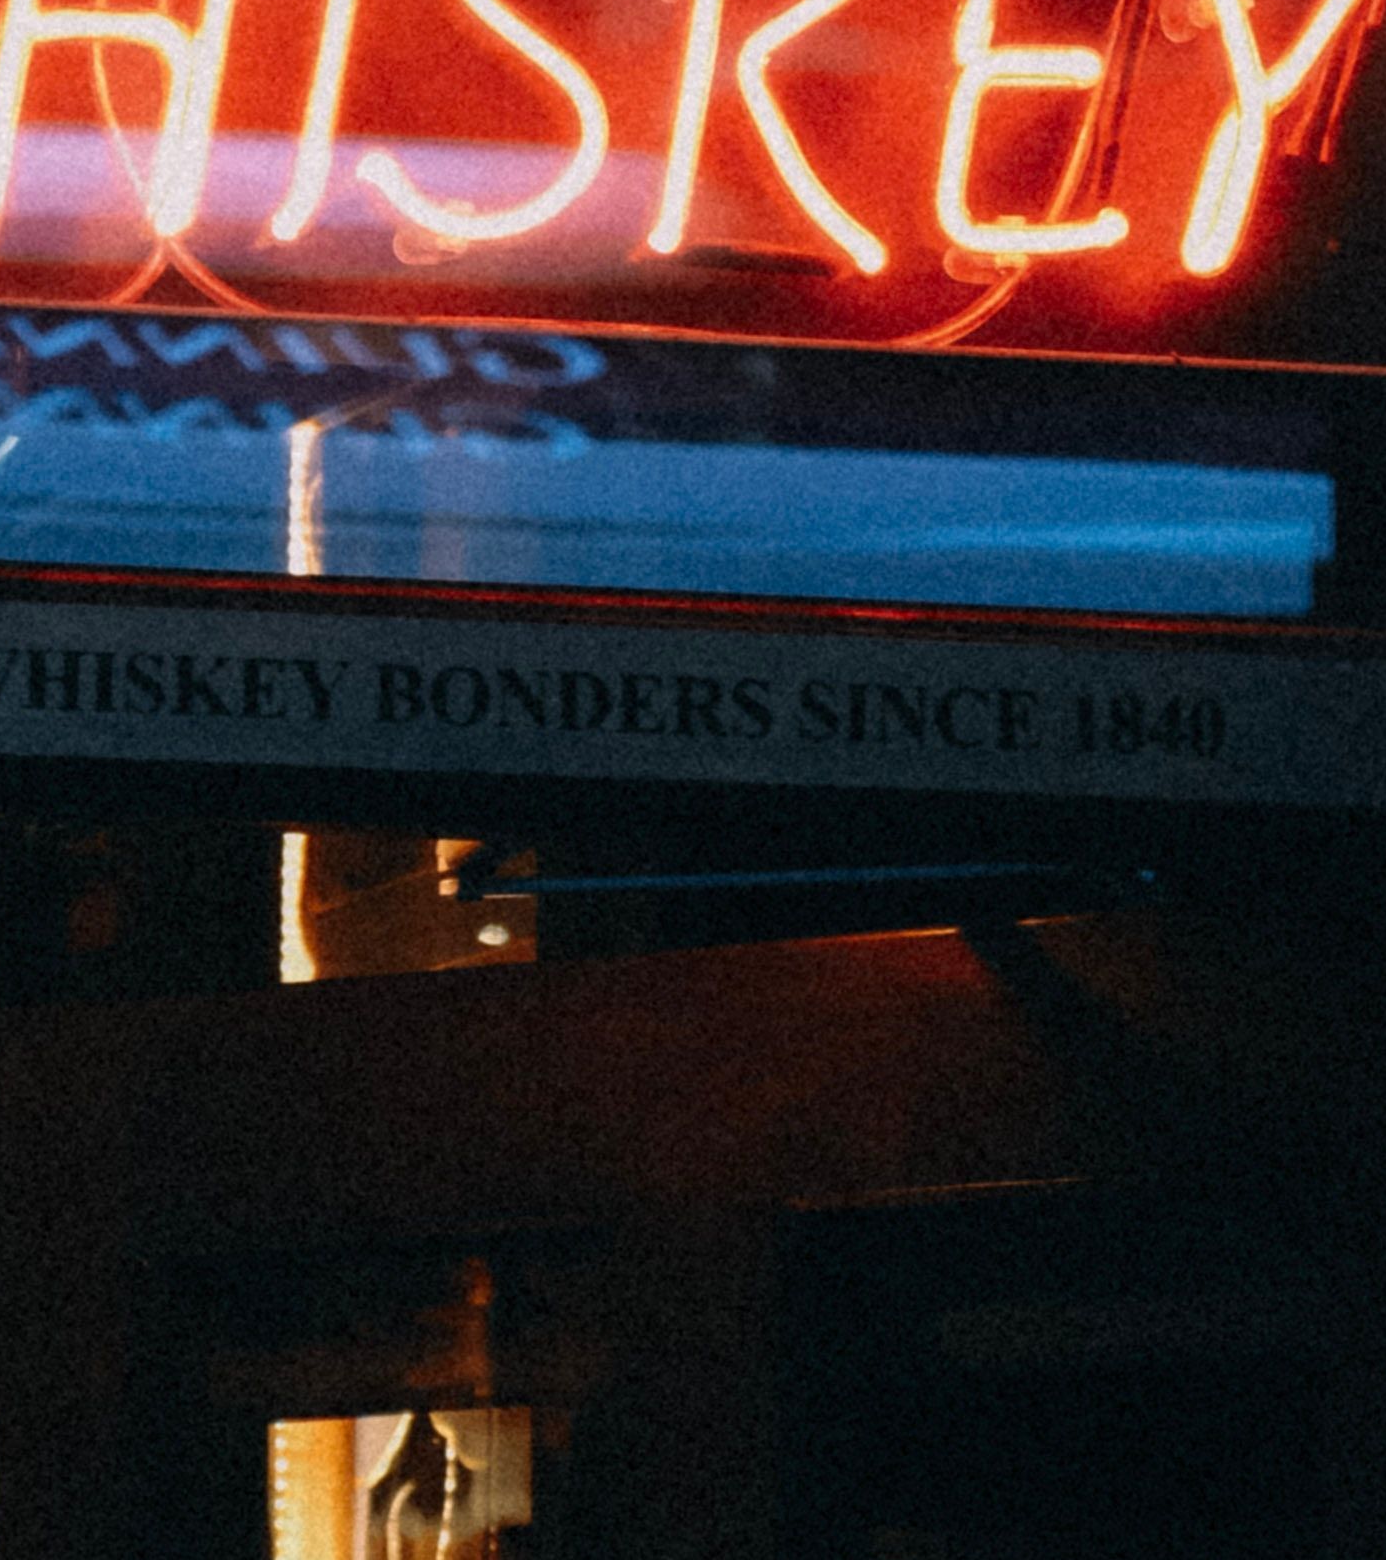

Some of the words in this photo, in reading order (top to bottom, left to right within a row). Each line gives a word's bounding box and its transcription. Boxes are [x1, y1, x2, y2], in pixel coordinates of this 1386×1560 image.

[374, 661, 773, 740] BONDERS
[798, 678, 1041, 753] SINCE
[1074, 691, 1227, 760] 1840
